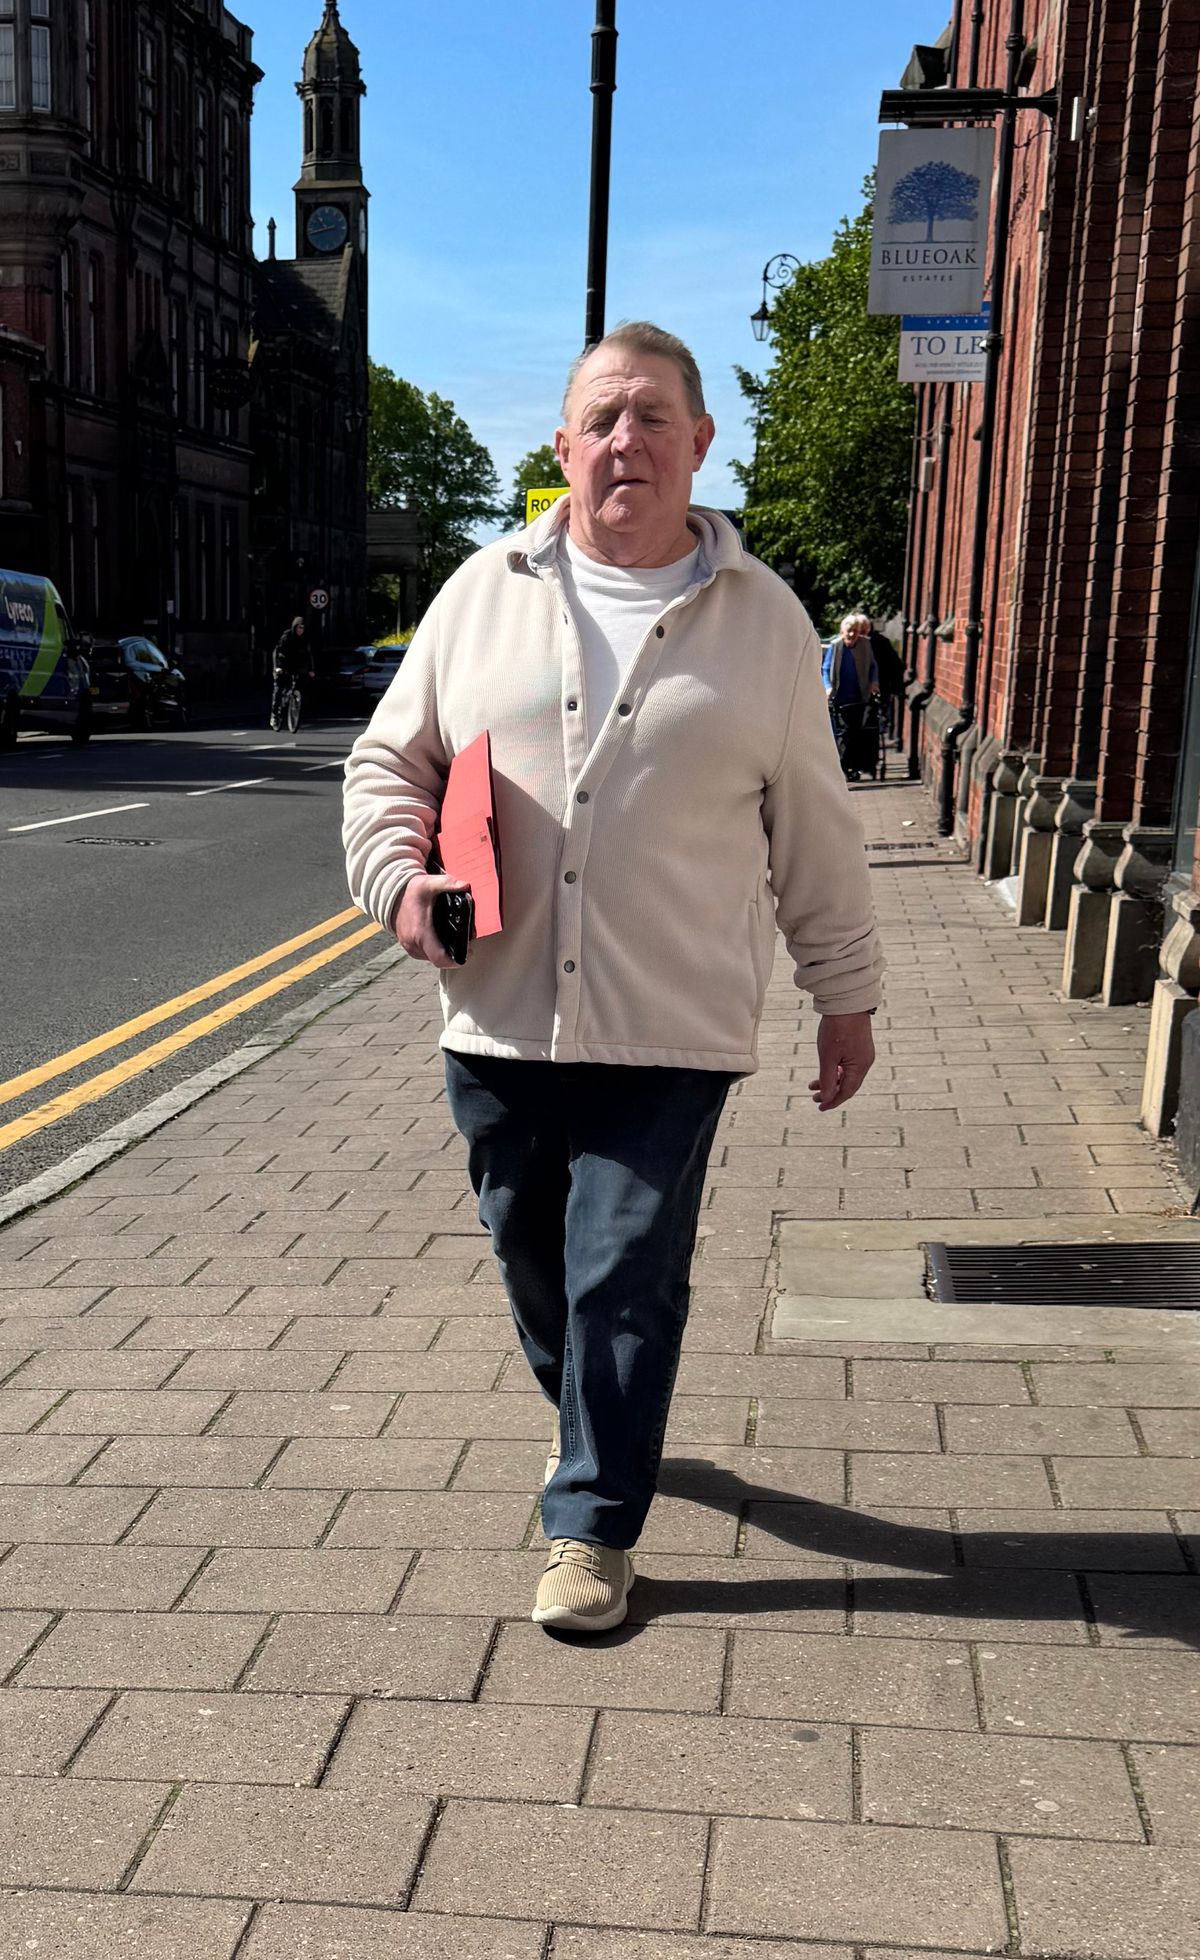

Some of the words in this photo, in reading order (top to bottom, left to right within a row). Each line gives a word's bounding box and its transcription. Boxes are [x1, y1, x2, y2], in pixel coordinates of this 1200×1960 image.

[881, 248, 977, 265] BLUEOAK
[910, 336, 946, 355] TO
[312, 594, 326, 604] 30
[4, 595, 34, 625] Lyreco
